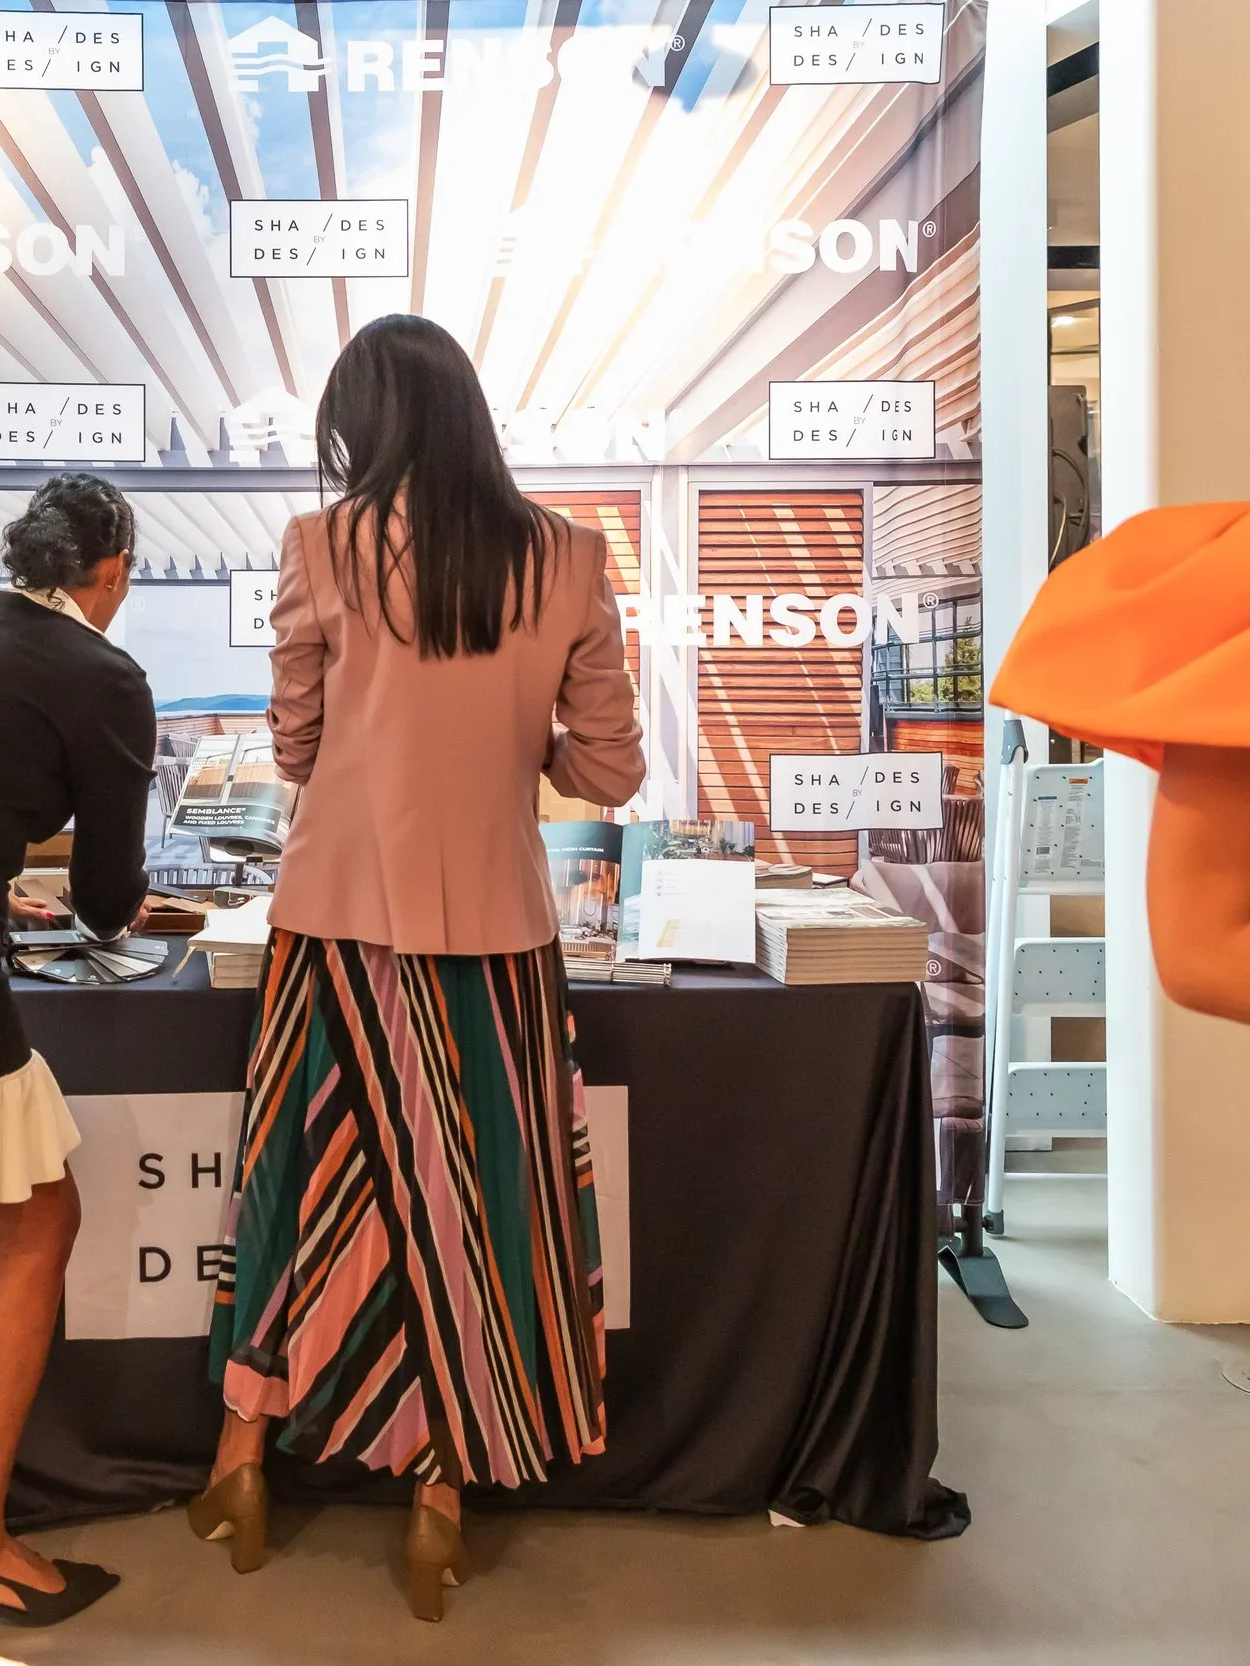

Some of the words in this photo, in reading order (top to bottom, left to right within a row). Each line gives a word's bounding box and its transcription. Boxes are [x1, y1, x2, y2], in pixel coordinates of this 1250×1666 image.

[794, 25, 838, 38] SHA
[880, 52, 924, 66] IGN
[76, 59, 120, 73] IGN
[254, 219, 299, 232] SHA
[340, 247, 386, 260] IGN
[793, 401, 839, 413] SHA
[78, 431, 122, 445] IGN
[882, 429, 912, 442] IGN
[254, 589, 278, 601] SH
[794, 773, 840, 786] SHA
[876, 799, 922, 815] IGN
[138, 1152, 222, 1189] SH
[139, 1244, 224, 1283] DE
